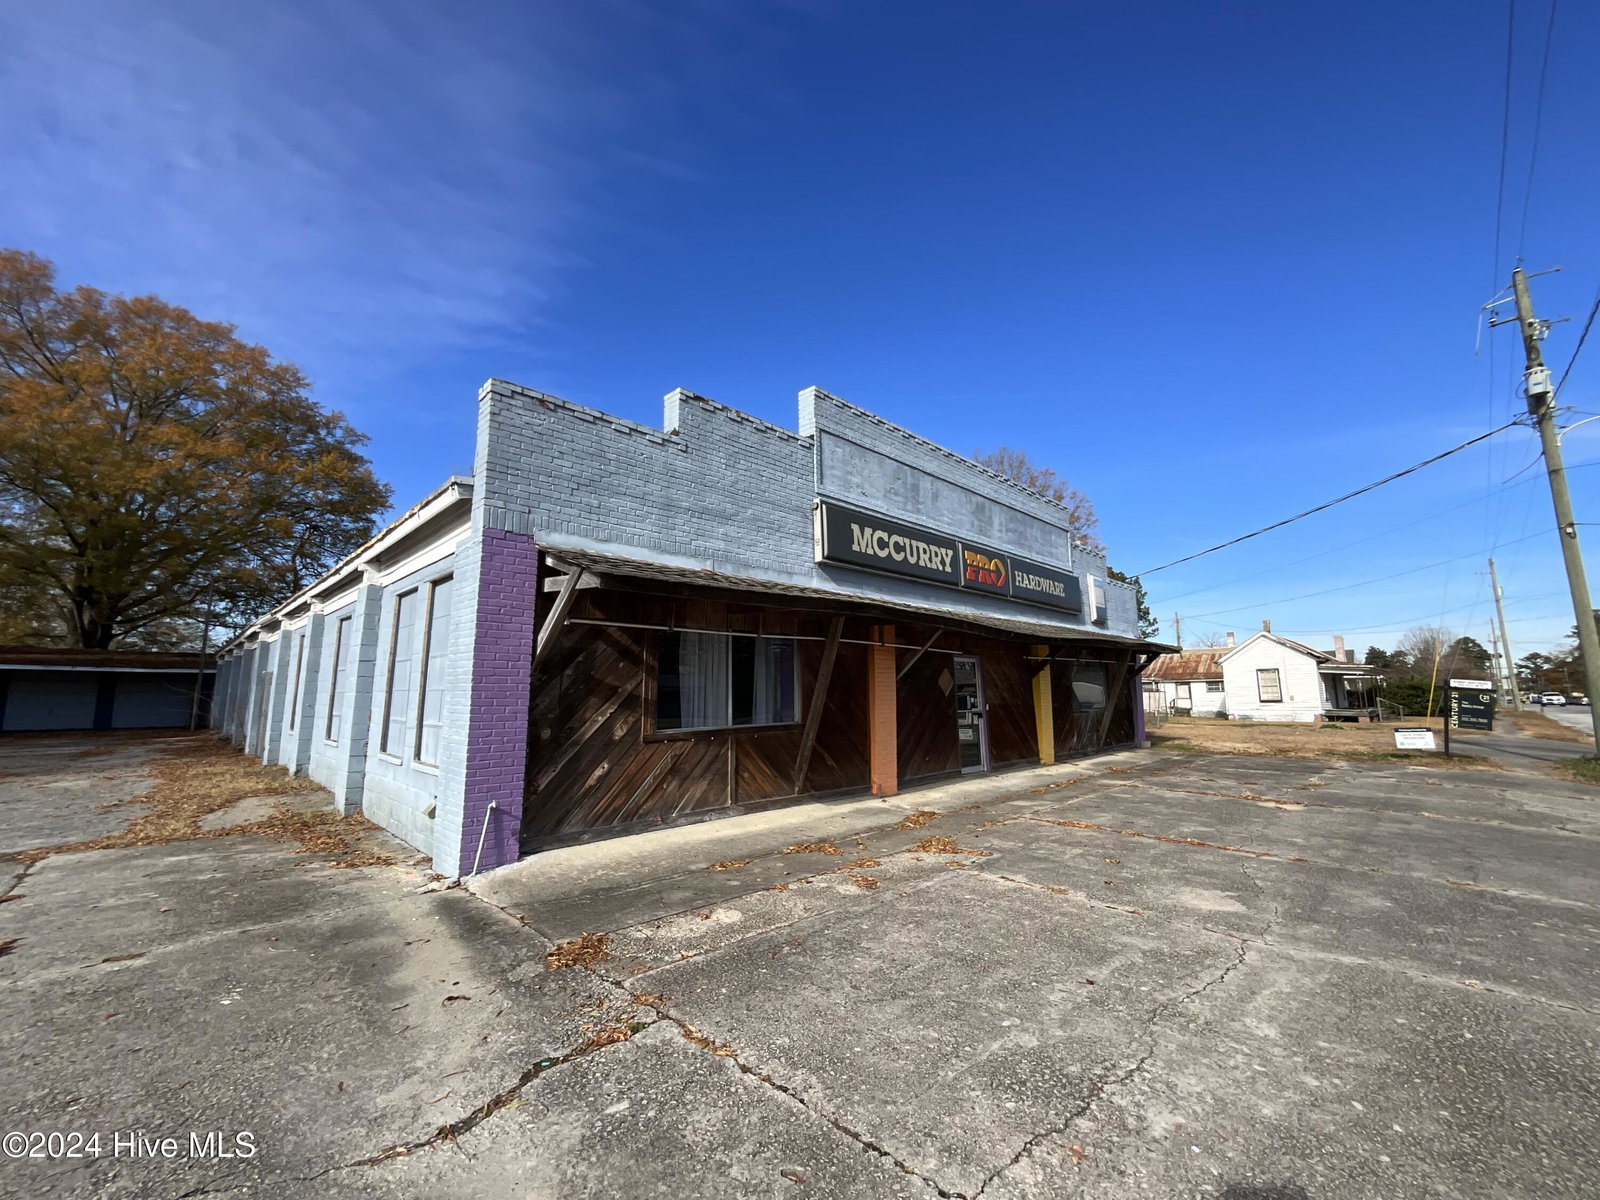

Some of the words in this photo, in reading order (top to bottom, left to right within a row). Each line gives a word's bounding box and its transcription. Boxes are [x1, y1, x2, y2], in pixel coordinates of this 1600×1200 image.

[851, 523, 953, 572] MCCURRY
[964, 550, 1006, 587] PRO
[1015, 571, 1065, 597] HARDWARE
[1451, 699, 1459, 728] CENTURY
